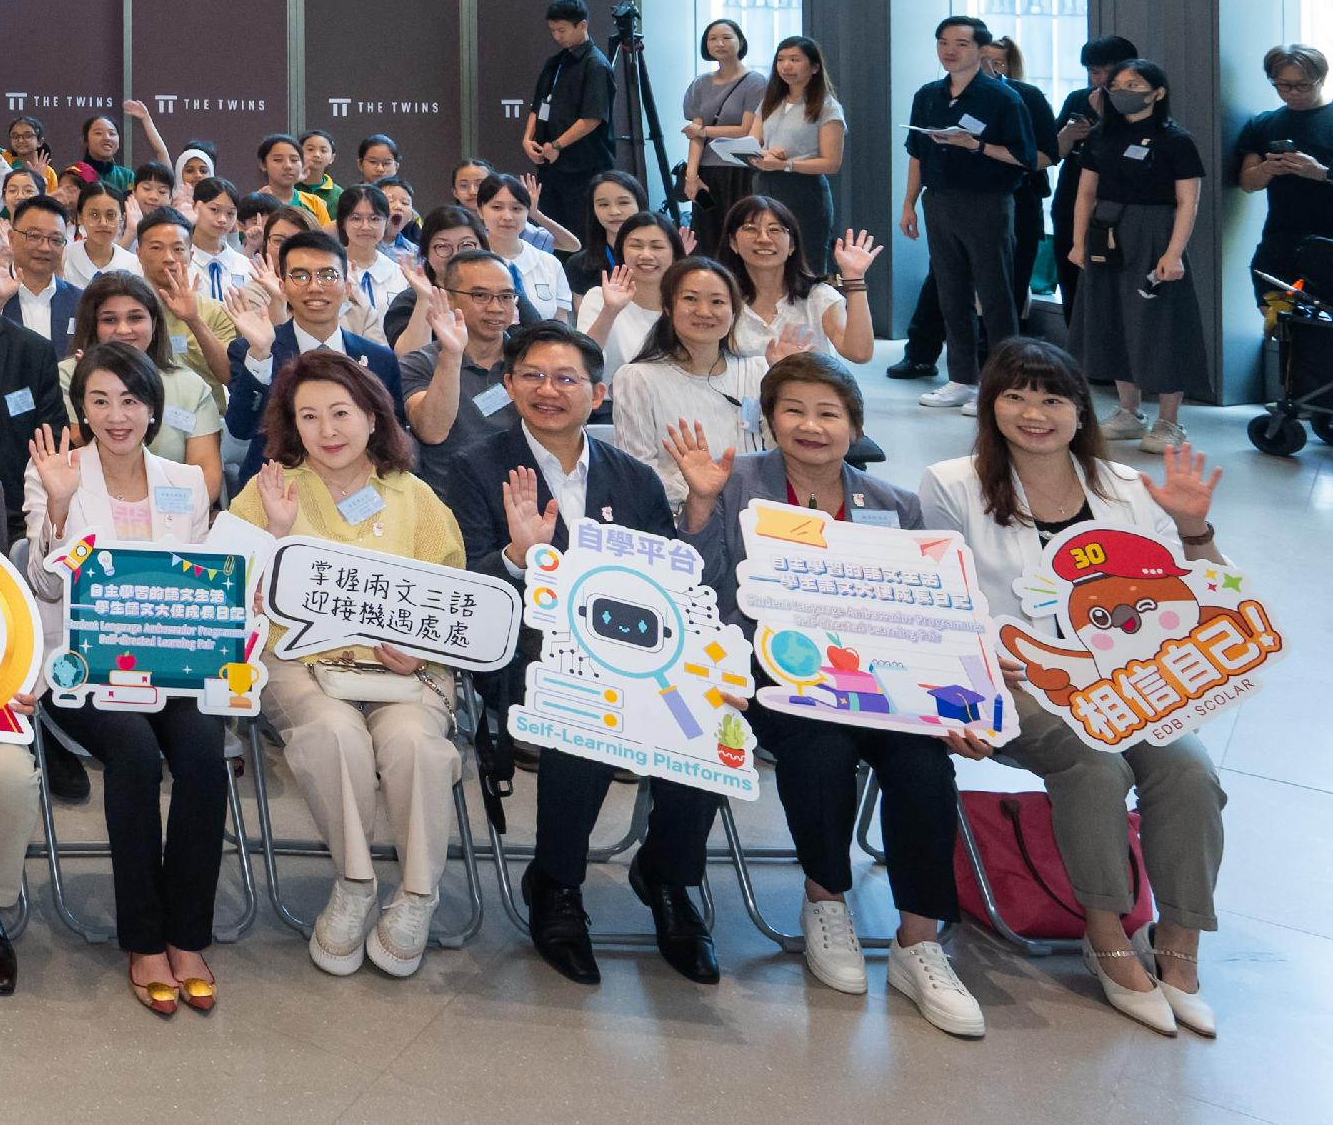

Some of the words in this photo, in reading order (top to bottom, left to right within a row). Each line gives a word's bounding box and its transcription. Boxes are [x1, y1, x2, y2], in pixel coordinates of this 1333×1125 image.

[33, 95, 59, 107] THE
[66, 96, 113, 108] TWINS
[183, 98, 210, 110] THE
[217, 99, 265, 111] TWINS
[357, 101, 384, 114] THE
[391, 101, 439, 114] TWINS
[576, 522, 699, 576] 自學平台
[1068, 542, 1107, 570] 30
[90, 583, 227, 604] 自主學習的語文生活
[310, 560, 478, 617] 掌握兩文三語
[771, 556, 943, 590] 自主學習的語文生活
[302, 590, 471, 649] 迎接機遇處處
[1075, 600, 1275, 738] 相信自己!
[1153, 718, 1183, 740] EDB
[1195, 678, 1255, 716] SCOLAR
[516, 714, 648, 767] Self-Learning
[653, 751, 753, 793] Platforms
